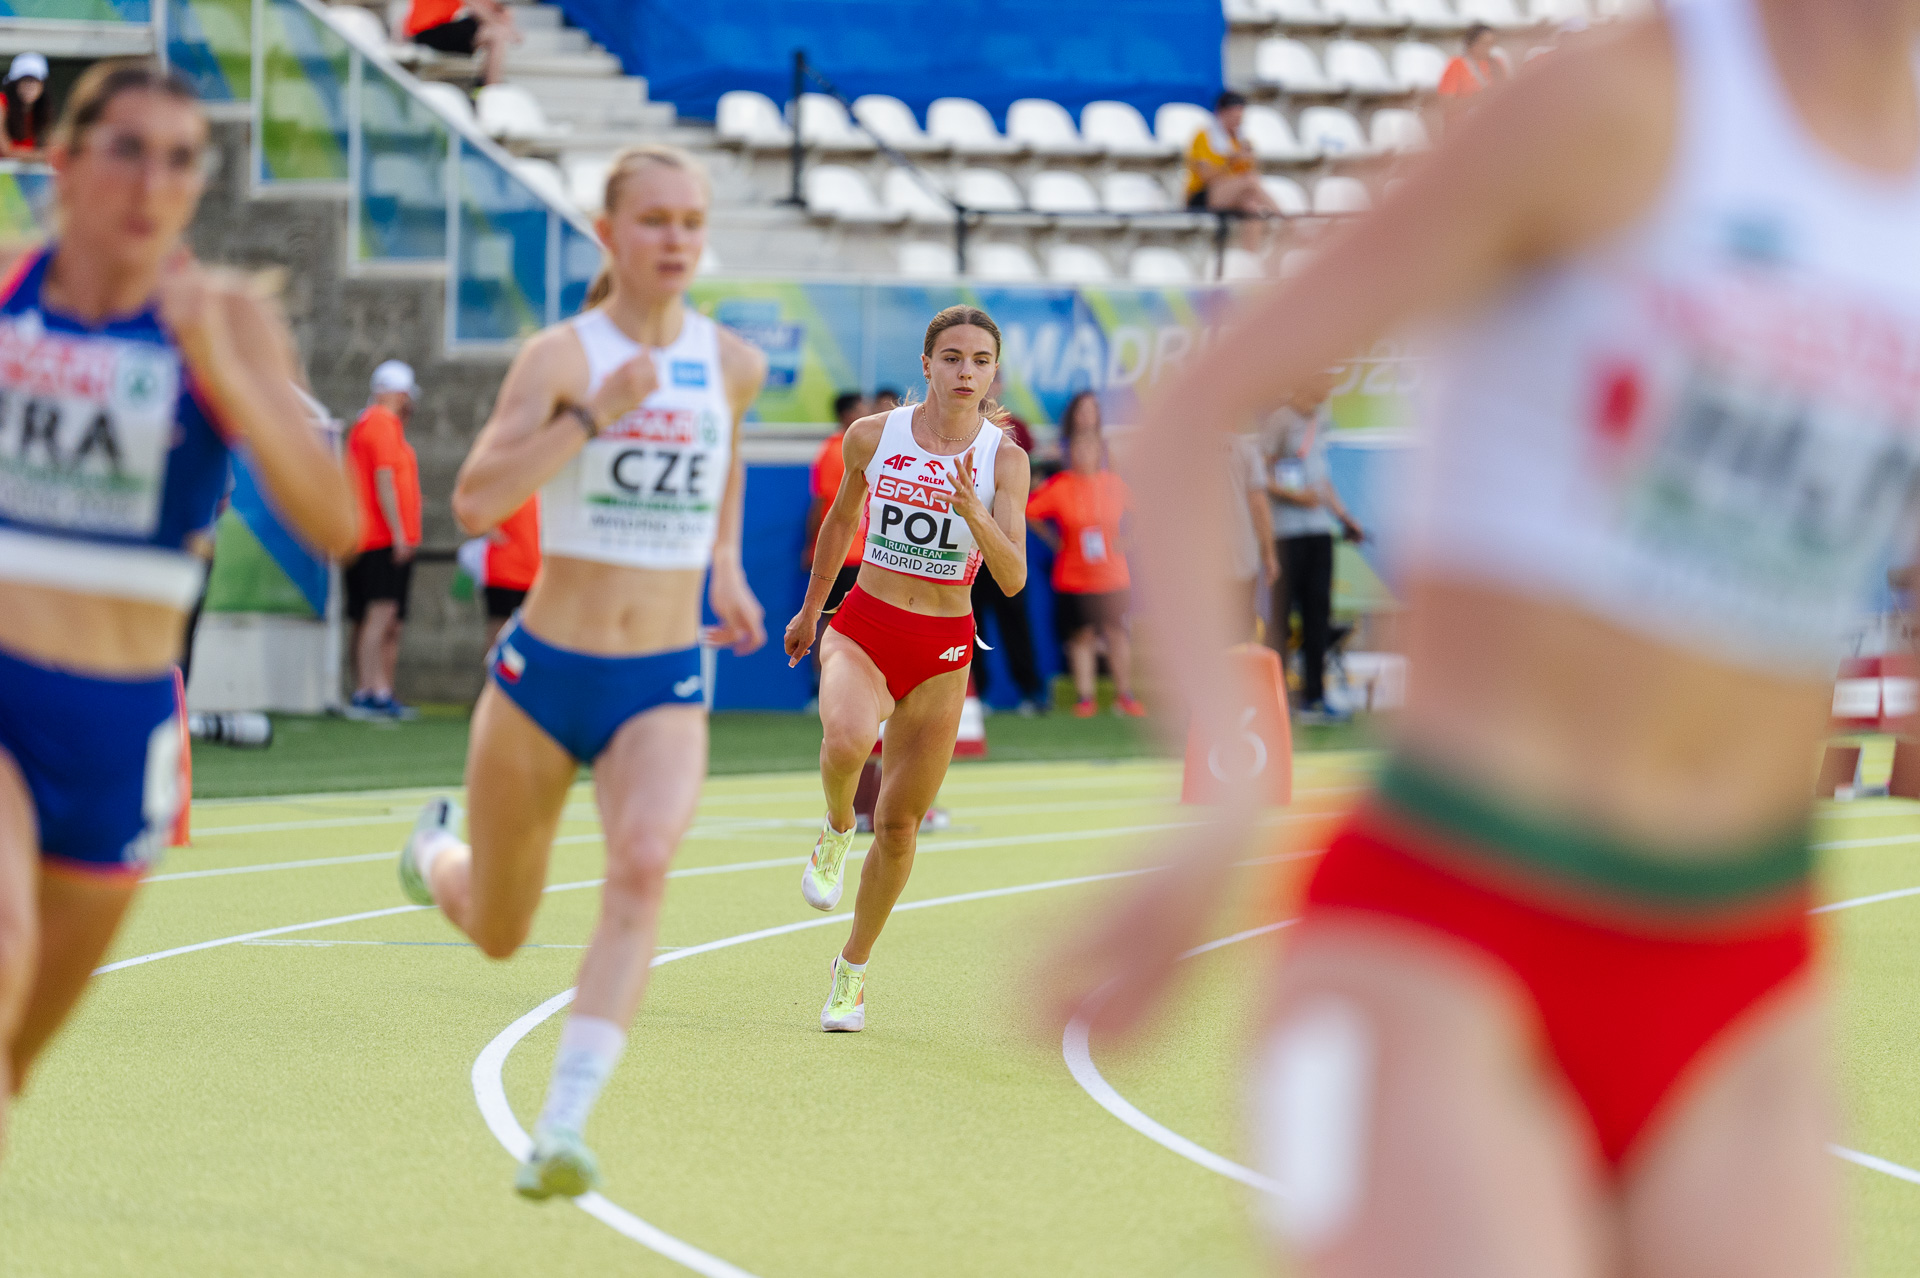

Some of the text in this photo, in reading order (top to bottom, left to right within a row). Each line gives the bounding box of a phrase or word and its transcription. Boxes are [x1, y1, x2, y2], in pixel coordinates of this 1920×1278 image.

[1003, 324, 1228, 389] MADR
[612, 448, 706, 495] CZE
[884, 453, 917, 471] 4F
[877, 478, 948, 511] SPAR
[917, 474, 945, 486] ORLEN
[880, 503, 958, 550] POL
[871, 547, 958, 576] MADRID 2025
[885, 539, 943, 559] I RUN CLEAN
[938, 644, 968, 662] 4F
[1207, 705, 1268, 783] 6
